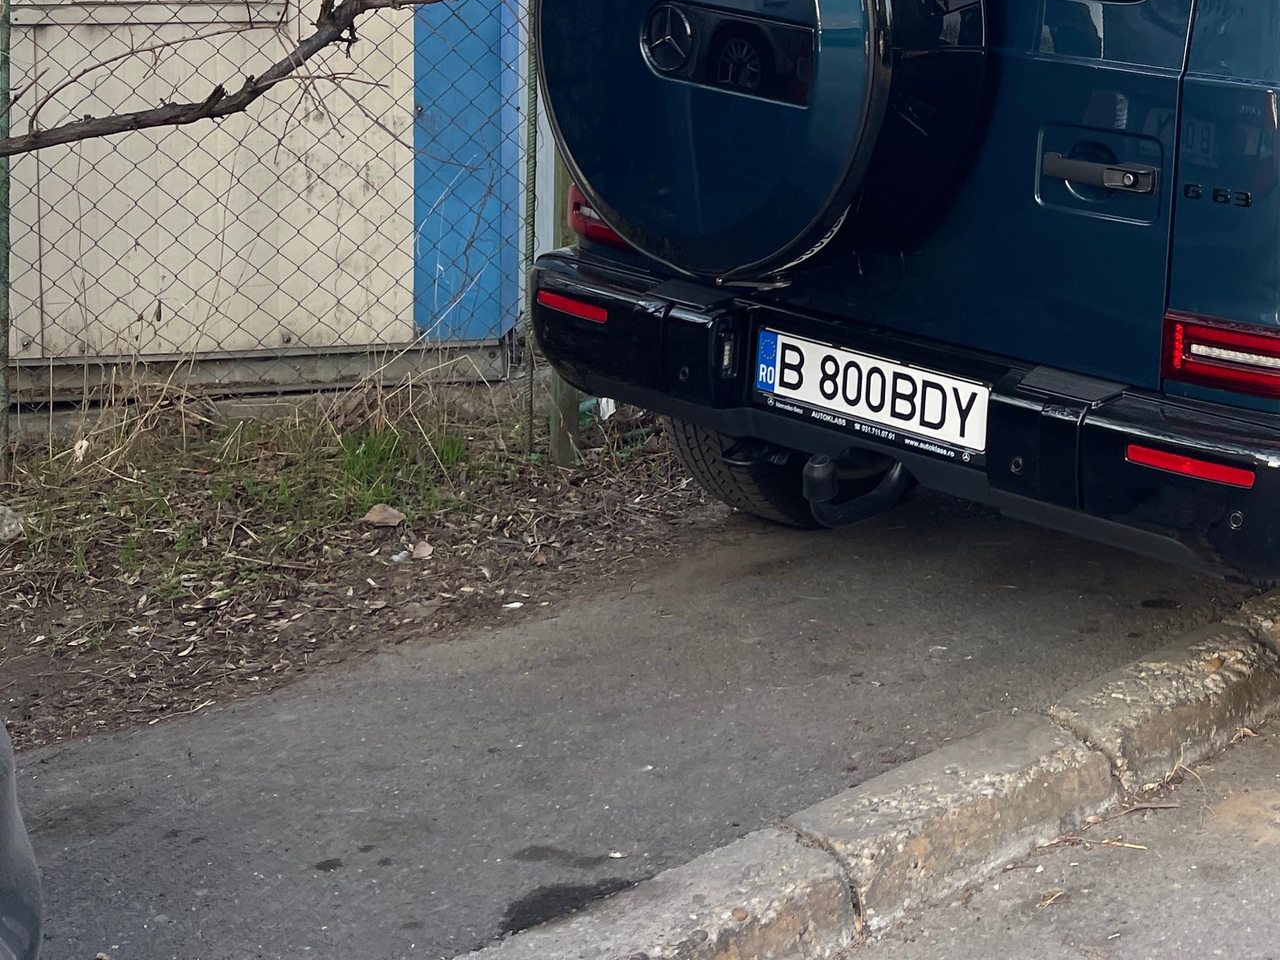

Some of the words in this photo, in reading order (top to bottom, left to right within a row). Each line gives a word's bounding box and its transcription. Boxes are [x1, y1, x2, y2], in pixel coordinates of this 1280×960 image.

[1184, 184, 1202, 200] G
[1212, 187, 1253, 208] 63
[759, 363, 775, 385] RO
[779, 342, 805, 391] B
[819, 354, 978, 438] 800BDY
[811, 410, 847, 427] AUTOKLASS
[904, 438, 955, 458] www.autoklass.ro
